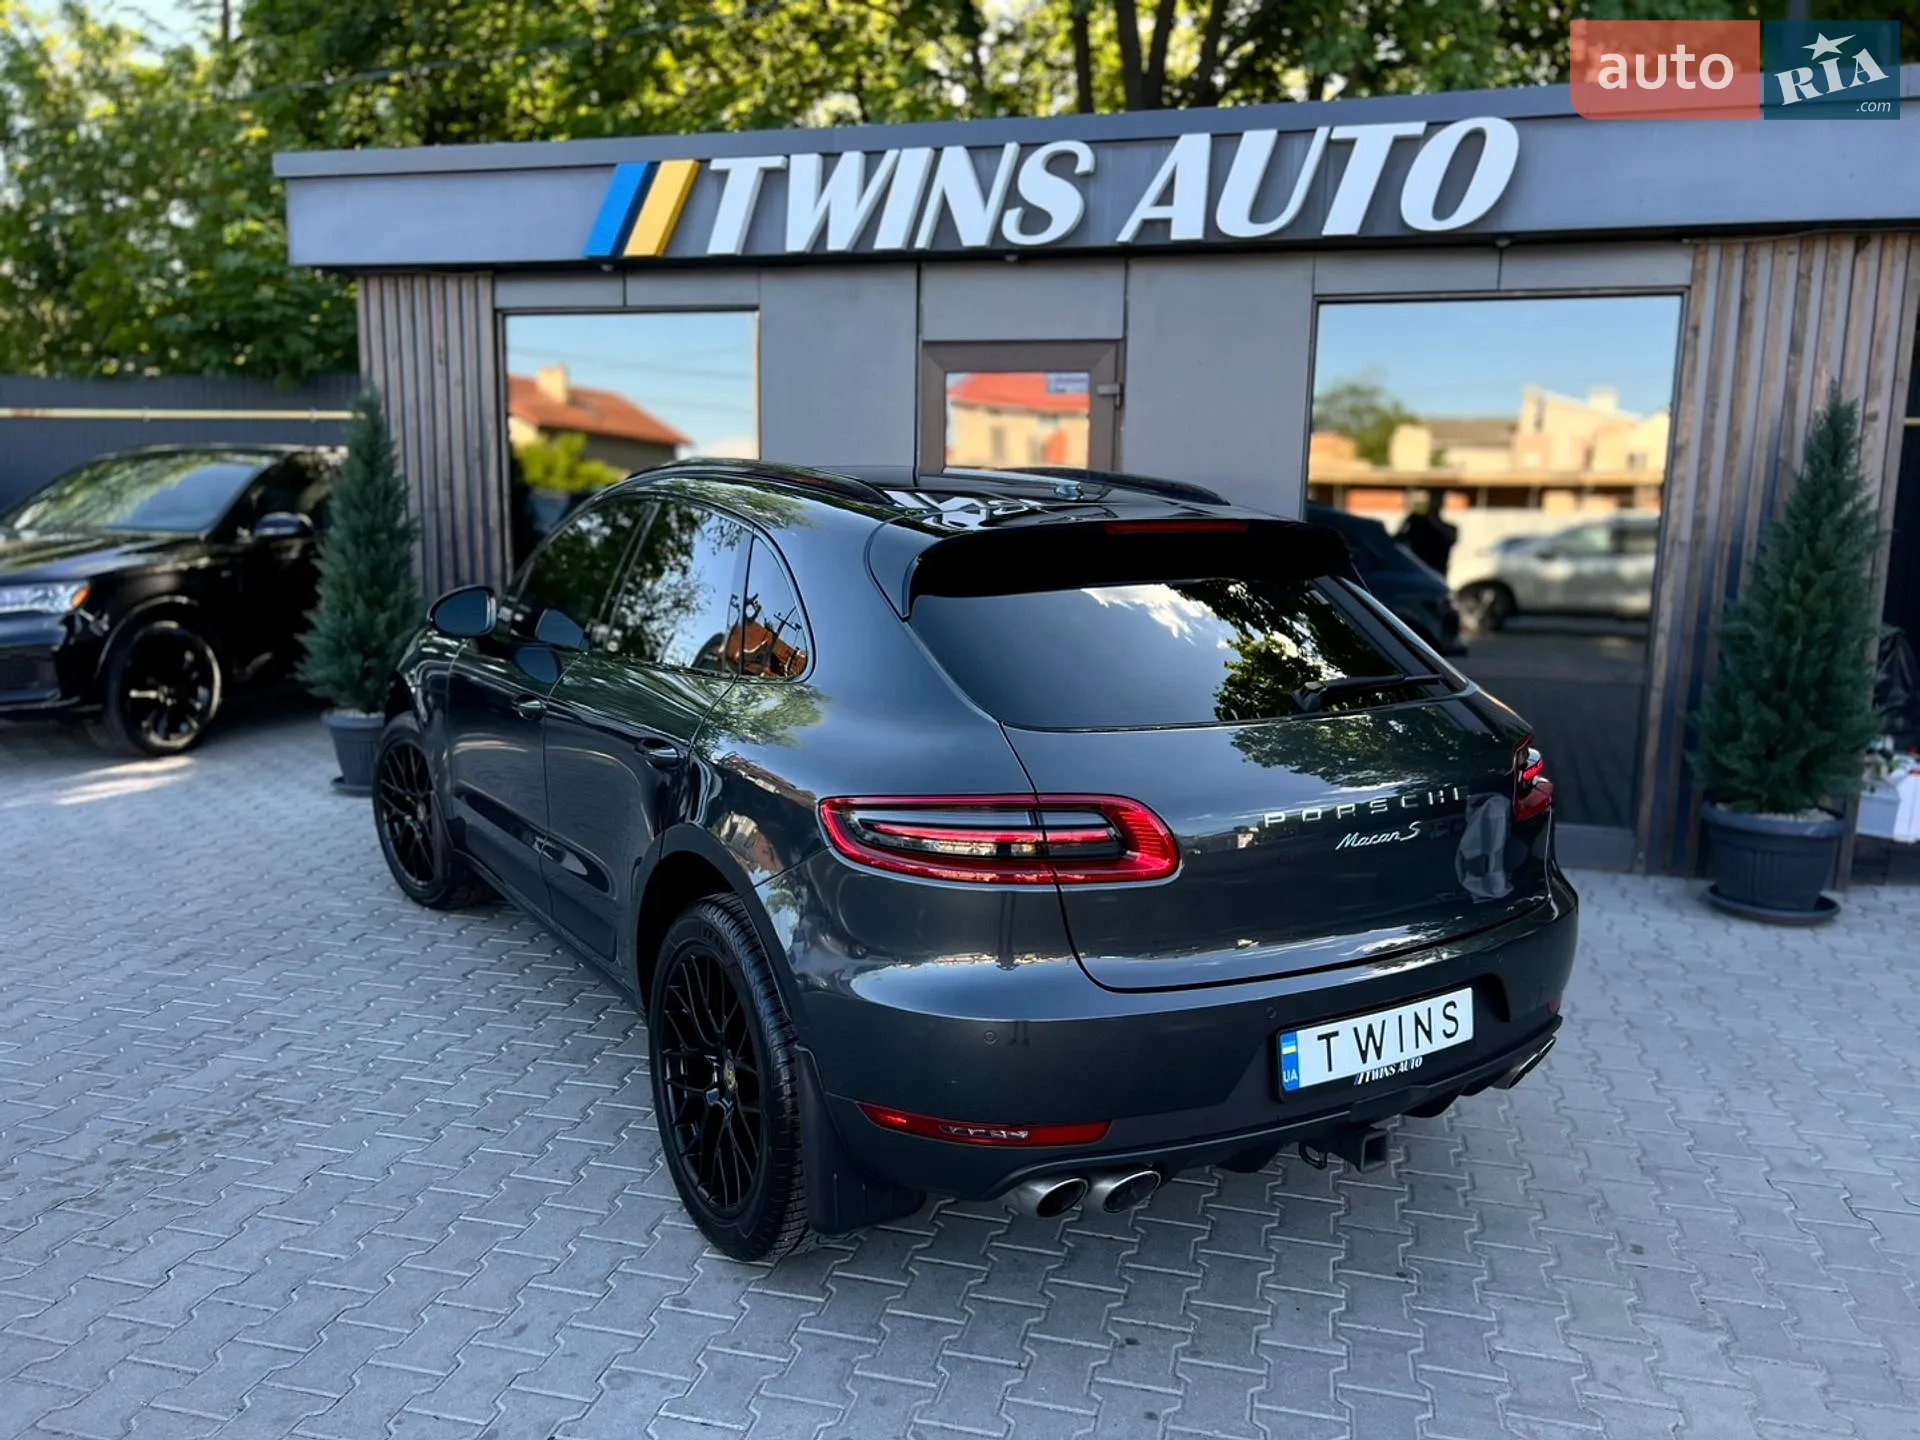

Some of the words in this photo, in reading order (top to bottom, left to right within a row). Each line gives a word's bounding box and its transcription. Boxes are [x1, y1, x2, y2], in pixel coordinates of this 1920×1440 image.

[706, 140, 1097, 256] TWINS
[1115, 116, 1521, 244] AUTO
[1335, 830, 1401, 851] Macan
[1400, 820, 1423, 842] S
[1316, 1000, 1460, 1073] TWINS
[1282, 1069, 1299, 1083] UA
[1365, 1063, 1398, 1083] TWINS
[1398, 1055, 1424, 1073] AUTO
